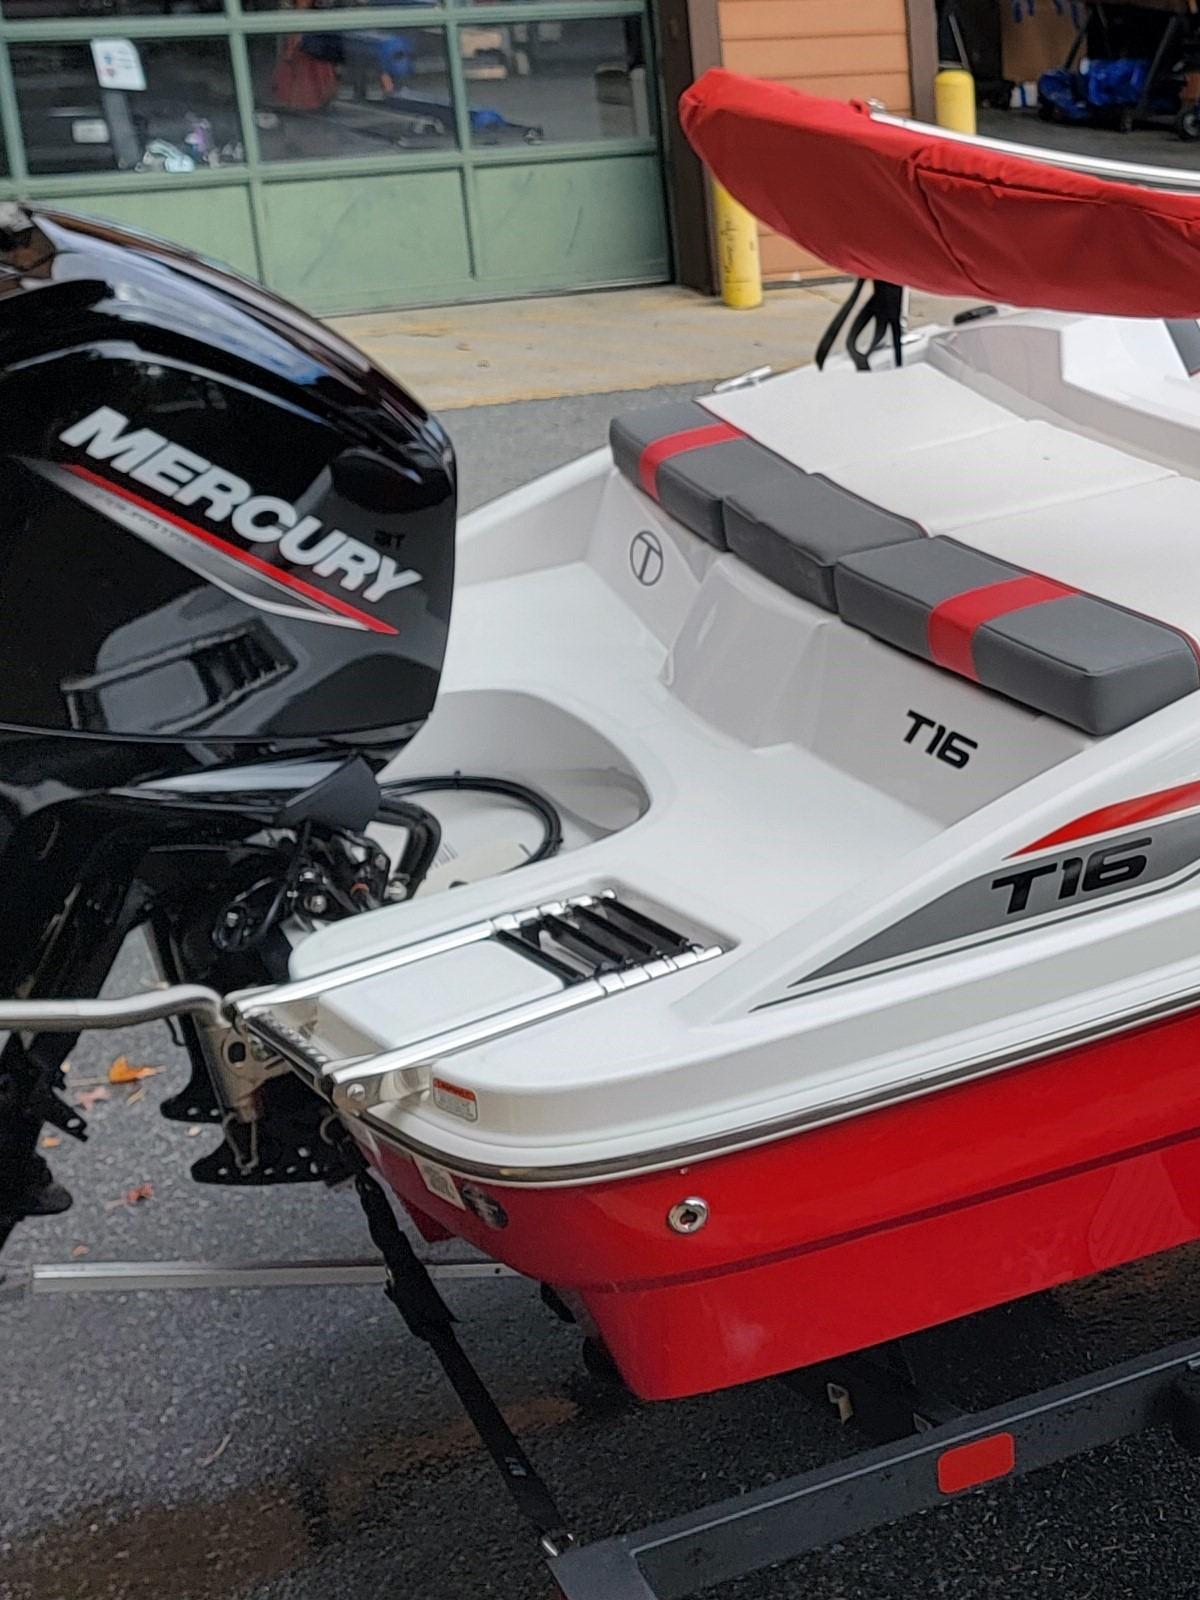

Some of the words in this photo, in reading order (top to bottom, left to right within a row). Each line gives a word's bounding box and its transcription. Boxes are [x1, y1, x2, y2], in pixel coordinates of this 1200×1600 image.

[58, 405, 423, 602] MERCURY
[903, 710, 978, 769] T16
[991, 837, 1152, 914] T16
